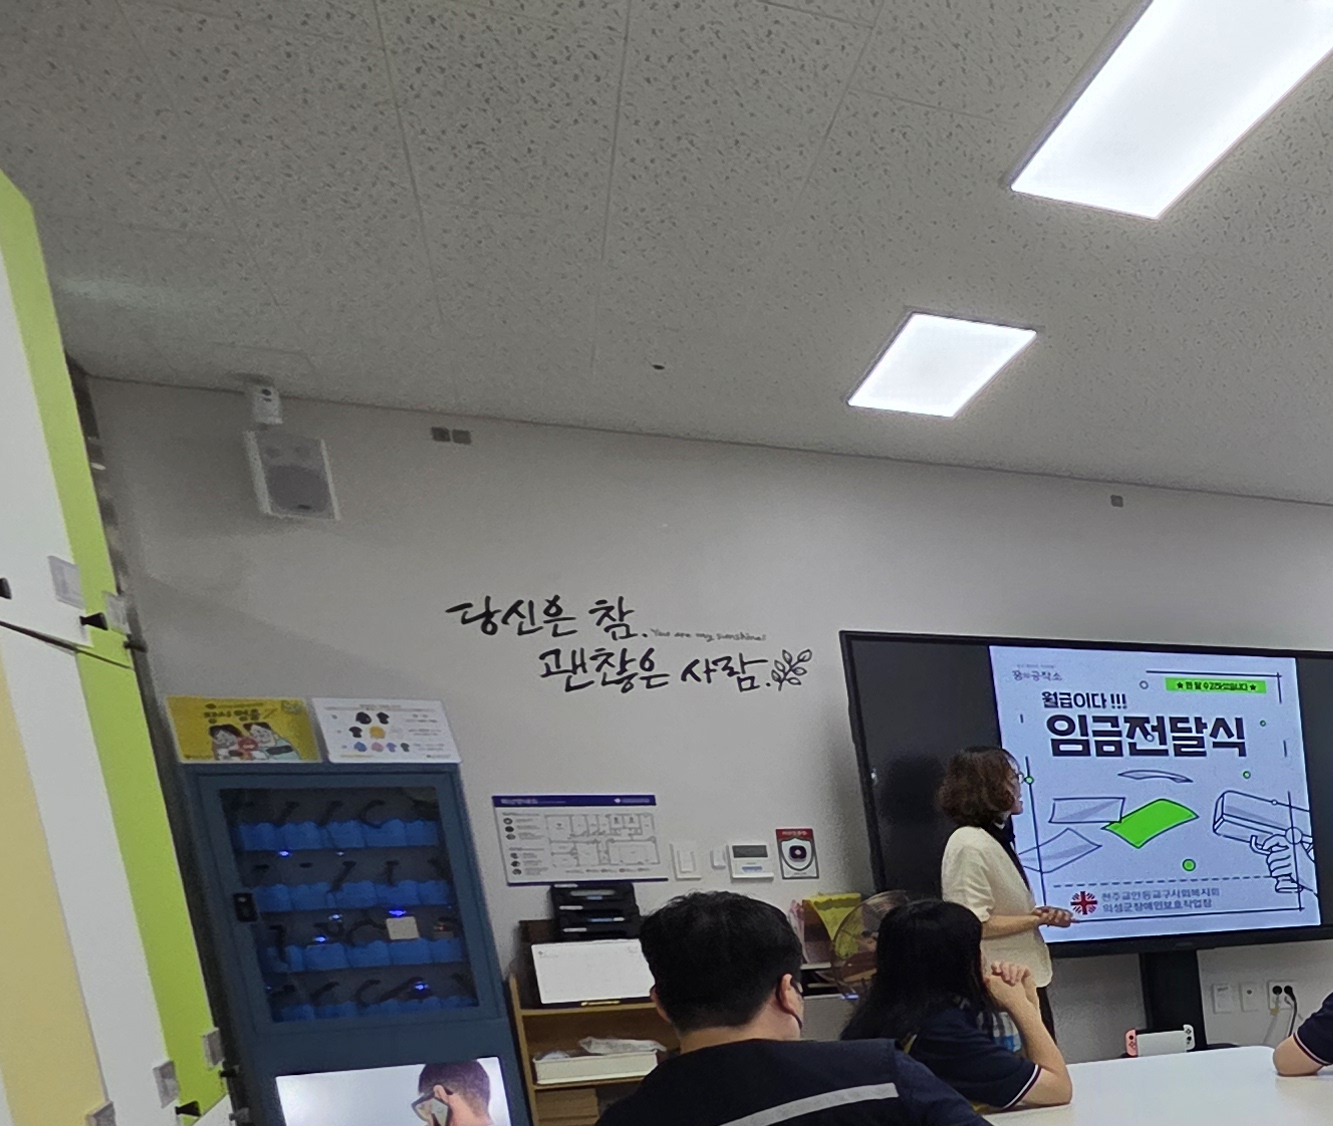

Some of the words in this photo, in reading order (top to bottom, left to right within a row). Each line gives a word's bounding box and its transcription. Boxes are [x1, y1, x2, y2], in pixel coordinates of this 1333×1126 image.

[445, 594, 577, 637] 당신은
[538, 647, 670, 693] 괜찮은
[1041, 691, 1107, 709] 월급이다
[1046, 713, 1248, 758] 임금전달식
